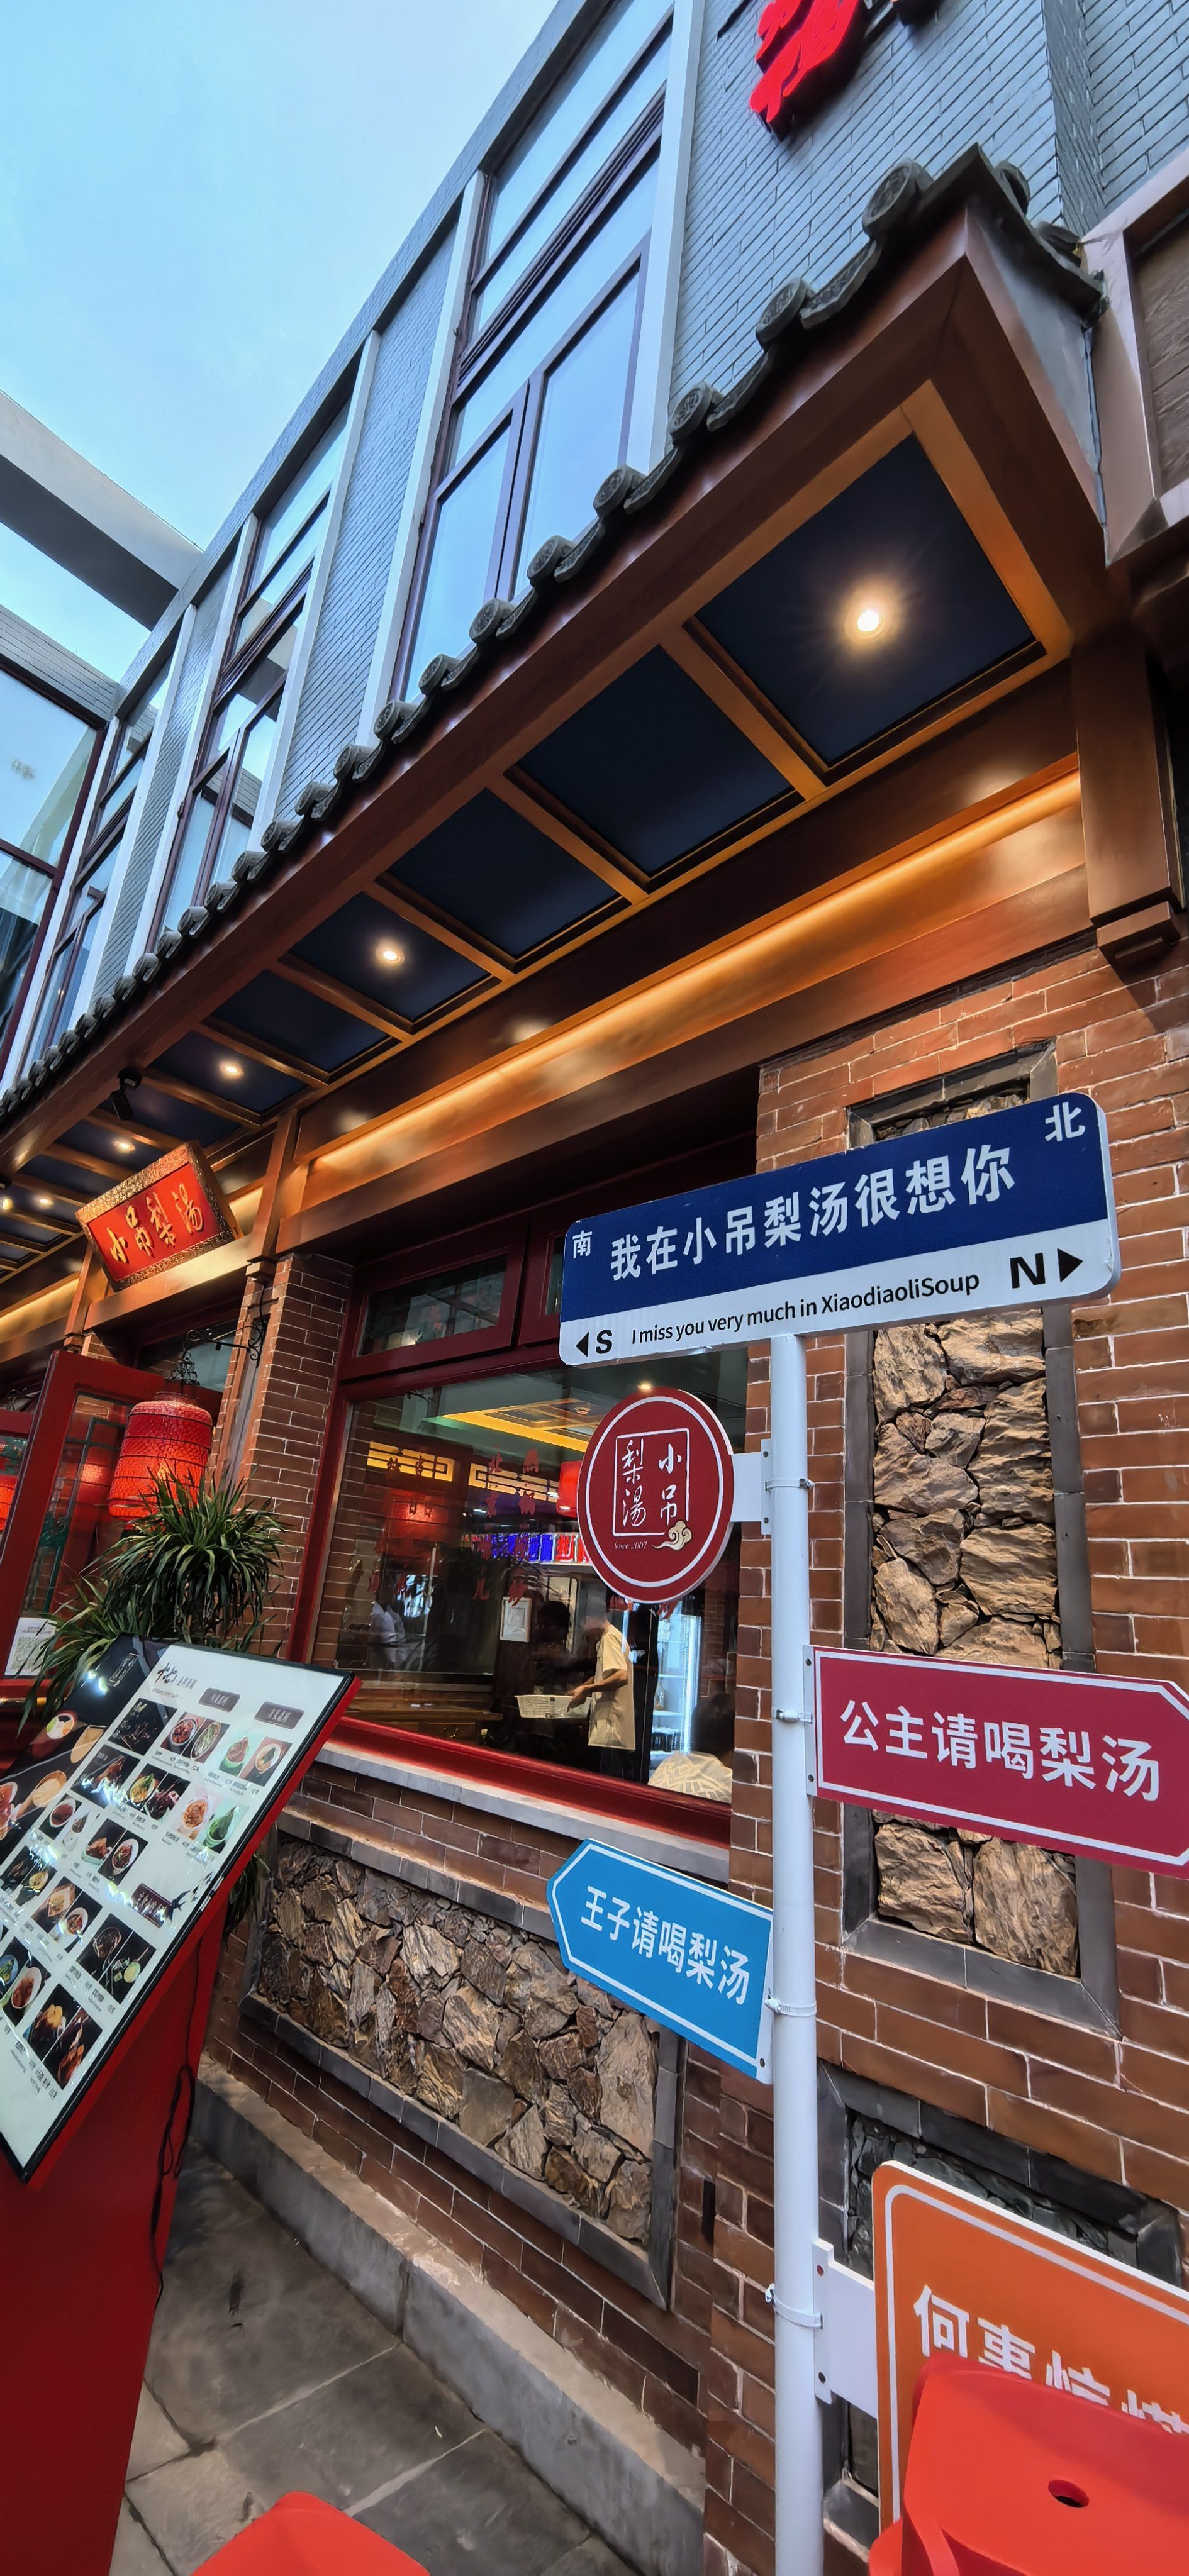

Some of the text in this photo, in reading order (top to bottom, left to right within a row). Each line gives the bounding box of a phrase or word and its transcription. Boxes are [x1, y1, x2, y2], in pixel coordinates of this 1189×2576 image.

[1044, 1102, 1085, 1143] 北
[572, 1230, 593, 1258] 南
[610, 1143, 1015, 1282] 我在小吊梨汤很想你
[1010, 1252, 1046, 1289] N
[595, 1329, 613, 1354] S
[632, 1273, 980, 1345] I miss you very much in XiaodiaoliSoup
[658, 1443, 683, 1526] 小吊
[614, 1541, 629, 1550] Since
[840, 1699, 1161, 1802] 公主请喝梨汤
[581, 1885, 750, 2006] 王子请喝梨汤
[913, 2284, 1189, 2434] 何事
